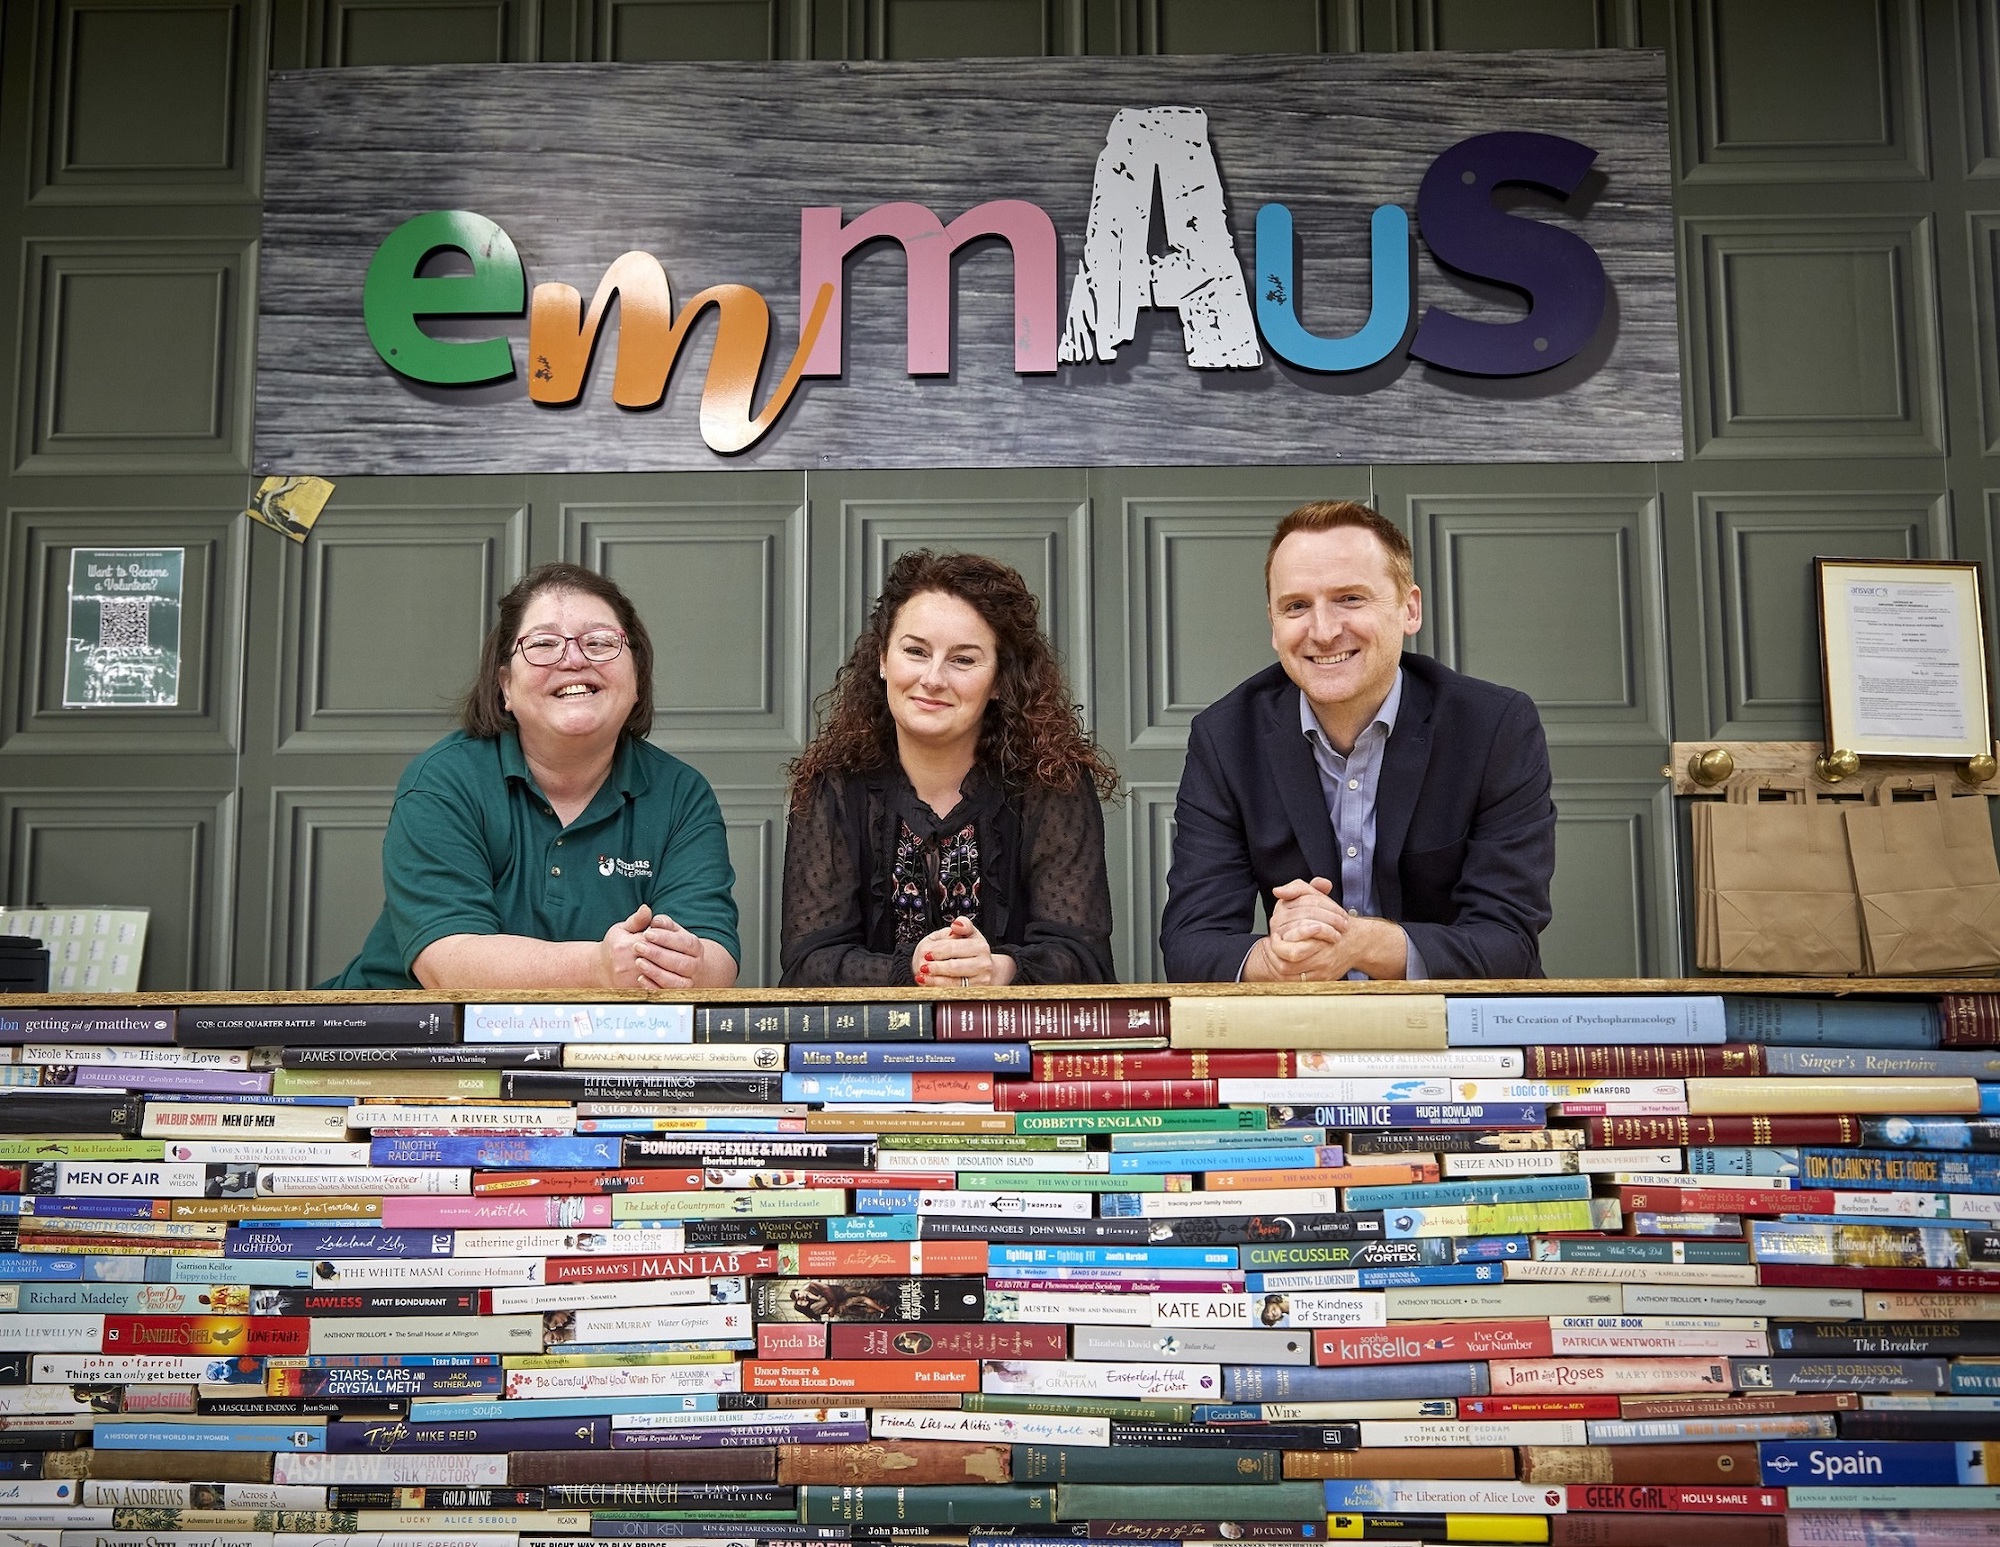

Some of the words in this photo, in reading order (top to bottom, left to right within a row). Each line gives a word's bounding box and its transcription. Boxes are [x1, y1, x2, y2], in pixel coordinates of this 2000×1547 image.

[88, 564, 113, 577] Want
[116, 565, 127, 577] to
[129, 564, 169, 578] Become
[104, 578, 158, 591] Volunteer?
[25, 1019, 68, 1032] getting
[70, 1019, 83, 1031] rid
[84, 1020, 94, 1031] of
[95, 1018, 151, 1030] matthew
[1494, 1015, 1514, 1024] The
[1517, 1015, 1559, 1025] Creation
[1562, 1015, 1572, 1025] of
[1576, 1014, 1677, 1026] Psychopharmacology
[27, 1048, 62, 1059] Nicole
[65, 1048, 102, 1061] Krauss
[122, 1050, 138, 1059] The
[139, 1049, 181, 1064] History
[182, 1053, 190, 1061] of
[191, 1051, 220, 1064] Love
[299, 1051, 336, 1062] JAMES
[338, 1050, 398, 1062] LOVELOCK
[803, 1052, 833, 1064] Miss
[834, 1051, 867, 1064] Read
[883, 1055, 914, 1063] Farewell
[925, 1055, 956, 1064] Fairacre
[1800, 1054, 1856, 1068] Singer's
[1866, 1055, 1937, 1071] Repertoire
[1315, 1106, 1335, 1125] ON
[1337, 1107, 1369, 1125] THIN
[1371, 1106, 1391, 1125] ICE
[1416, 1105, 1441, 1118] HUGH
[1443, 1106, 1483, 1118] ROWLAND
[155, 1113, 188, 1126] WILBUR
[189, 1114, 217, 1126] SMITH
[221, 1114, 242, 1127] MEN
[243, 1114, 254, 1127] OF
[254, 1114, 275, 1127] MEN
[356, 1113, 386, 1122] GITA
[392, 1113, 439, 1122] MEHTA
[450, 1114, 457, 1124] A
[461, 1114, 497, 1124] RIVER
[503, 1114, 542, 1124] SUTRA
[1023, 1116, 1095, 1129] COBBETT'S
[1100, 1116, 1162, 1128] ENGLAND
[393, 1140, 438, 1151] TIMOTHY
[388, 1151, 442, 1162] RADCLIFFE
[1453, 1158, 1485, 1170] SEIZE
[1488, 1157, 1515, 1169] AND
[1518, 1157, 1553, 1168] HOLD
[67, 1172, 100, 1185] MEN
[107, 1172, 129, 1185] OF
[131, 1172, 159, 1185] AIR
[812, 1174, 854, 1186] Pinocchio
[474, 1205, 528, 1218] Matilda
[248, 1234, 281, 1244] FREDA
[465, 1237, 514, 1248] catherine
[516, 1237, 559, 1250] gildiner
[233, 1243, 294, 1253] LIGHTFOOT
[1367, 1244, 1416, 1255] PACIFIC
[1251, 1250, 1288, 1264] CLIVE
[1289, 1248, 1349, 1263] CUSSLER
[1364, 1252, 1421, 1263] VORTEX!
[558, 1266, 593, 1279] JAMES
[595, 1263, 629, 1276] MAY'S
[640, 1258, 698, 1276] MAN
[701, 1254, 740, 1274] LAB
[343, 1268, 366, 1278] THE
[369, 1268, 407, 1278] WHITE
[409, 1267, 443, 1277] MASAI
[447, 1267, 482, 1277] Corinne
[484, 1267, 524, 1277] Hofmann
[30, 1292, 77, 1305] Richard
[80, 1292, 129, 1307] Madeley
[304, 1297, 362, 1309] LAWLESS
[372, 1298, 395, 1308] MATT
[396, 1297, 447, 1307] BONDURANT
[1294, 1299, 1313, 1310] The
[1316, 1299, 1363, 1310] Kindness
[1158, 1302, 1200, 1318] KATE
[1206, 1302, 1247, 1318] ADIE
[1298, 1311, 1310, 1322] of
[1312, 1311, 1361, 1325] Strangers
[1563, 1318, 1595, 1328] CRICKET
[1597, 1318, 1618, 1329] QUIZ
[1620, 1318, 1643, 1328] BOOK
[1474, 1332, 1493, 1342] I've
[1495, 1331, 1513, 1342] Got
[1816, 1325, 1887, 1338] MINETTE
[1892, 1325, 1959, 1337] WALTERS
[1360, 1334, 1388, 1345] sophie
[1563, 1337, 1607, 1348] PATRICIA
[1610, 1338, 1676, 1348] WENTWORTH
[1853, 1338, 1877, 1351] The
[1881, 1338, 1928, 1352] Breaker
[1340, 1336, 1421, 1360] kinsella
[1466, 1342, 1488, 1352] Your
[1490, 1339, 1533, 1352] Number
[83, 1358, 119, 1369] john
[122, 1358, 183, 1368] o'farrell
[65, 1371, 101, 1381] Things
[123, 1372, 146, 1382] only
[147, 1372, 166, 1382] get
[167, 1371, 202, 1380] better
[329, 1369, 374, 1382] STARS,
[378, 1369, 410, 1381] CARS
[413, 1371, 425, 1381] AND
[449, 1372, 468, 1380] JACK
[811, 1367, 820, 1376] &
[915, 1372, 930, 1381] Pat
[932, 1372, 966, 1381] Barker
[1506, 1366, 1539, 1387] Jam
[1541, 1370, 1555, 1380] and
[1556, 1366, 1604, 1386] Roses
[329, 1381, 383, 1394] CRYSTAL
[386, 1381, 421, 1393] METH
[433, 1380, 482, 1389] SUTHERLAND
[210, 1404, 217, 1412] A
[218, 1404, 264, 1412] MASCULINE
[266, 1404, 297, 1412] ENDING
[303, 1403, 318, 1413] Jean
[318, 1404, 339, 1412] Smith
[416, 1430, 444, 1441] MIKE
[449, 1430, 477, 1441] REID
[1810, 1450, 1883, 1480] Spain
[95, 1486, 119, 1506] LYN
[123, 1486, 183, 1506] ANDREWS
[442, 1491, 465, 1506] GOLD
[467, 1491, 492, 1506] MINE
[1393, 1492, 1411, 1502] The
[1416, 1491, 1470, 1502] Liberation
[1471, 1491, 1481, 1502] of
[1483, 1492, 1508, 1503] Alice
[1511, 1492, 1535, 1503] Love
[1681, 1493, 1714, 1504] HOLLY
[1716, 1494, 1748, 1504] SMALE
[868, 1526, 889, 1535] John
[891, 1526, 930, 1535] Banville
